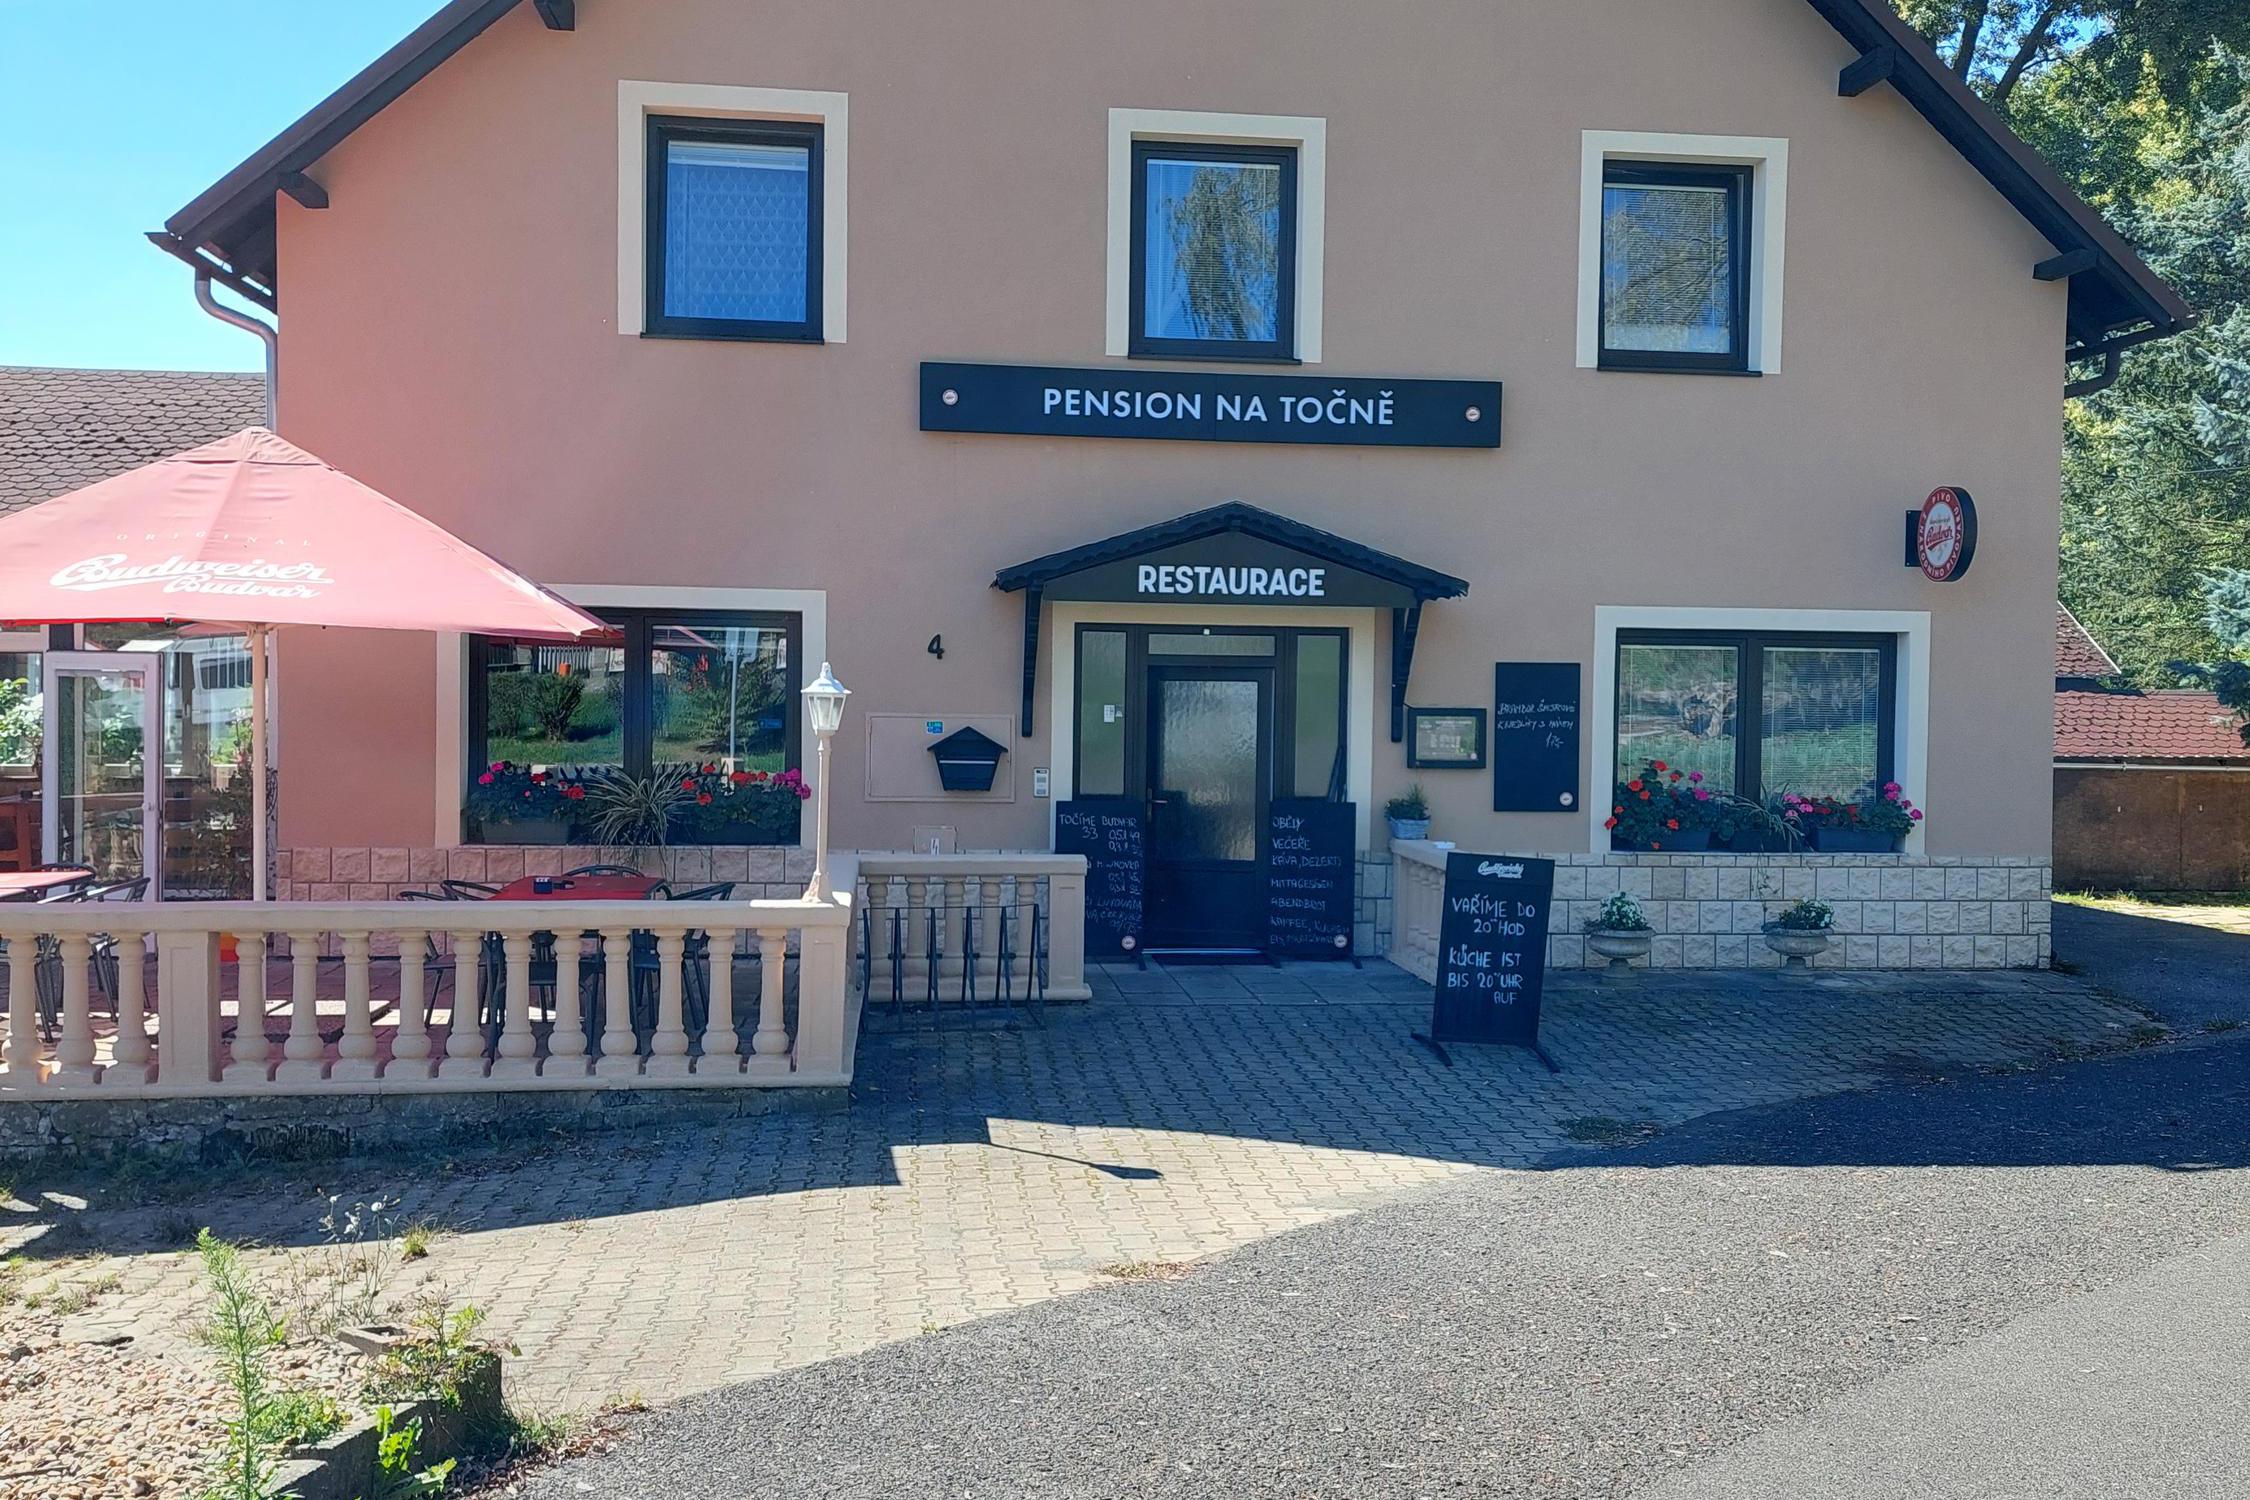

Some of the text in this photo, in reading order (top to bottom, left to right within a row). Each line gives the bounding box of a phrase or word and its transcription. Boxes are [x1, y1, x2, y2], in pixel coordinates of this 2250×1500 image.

[1043, 387, 1394, 425] PENSION NA TOČNĚ
[1931, 491, 1951, 504] PIVO
[116, 529, 312, 547] ORIGINAL
[50, 553, 335, 592] Budweiser
[1138, 564, 1325, 597] RESTAURACE
[163, 574, 323, 598] Budvar
[927, 634, 945, 659] 4
[1058, 812, 1096, 827] TOČÍME
[1081, 826, 1098, 840] 33
[1272, 835, 1311, 851] VEČEŘE
[1451, 893, 1536, 918] VAŘÍME DO
[1498, 920, 1525, 936] HOD
[1449, 944, 1522, 968] KÜCHE IST
[1447, 973, 1469, 988] BIS
[1500, 974, 1524, 990] UHR
[1494, 991, 1518, 1005] AUF
